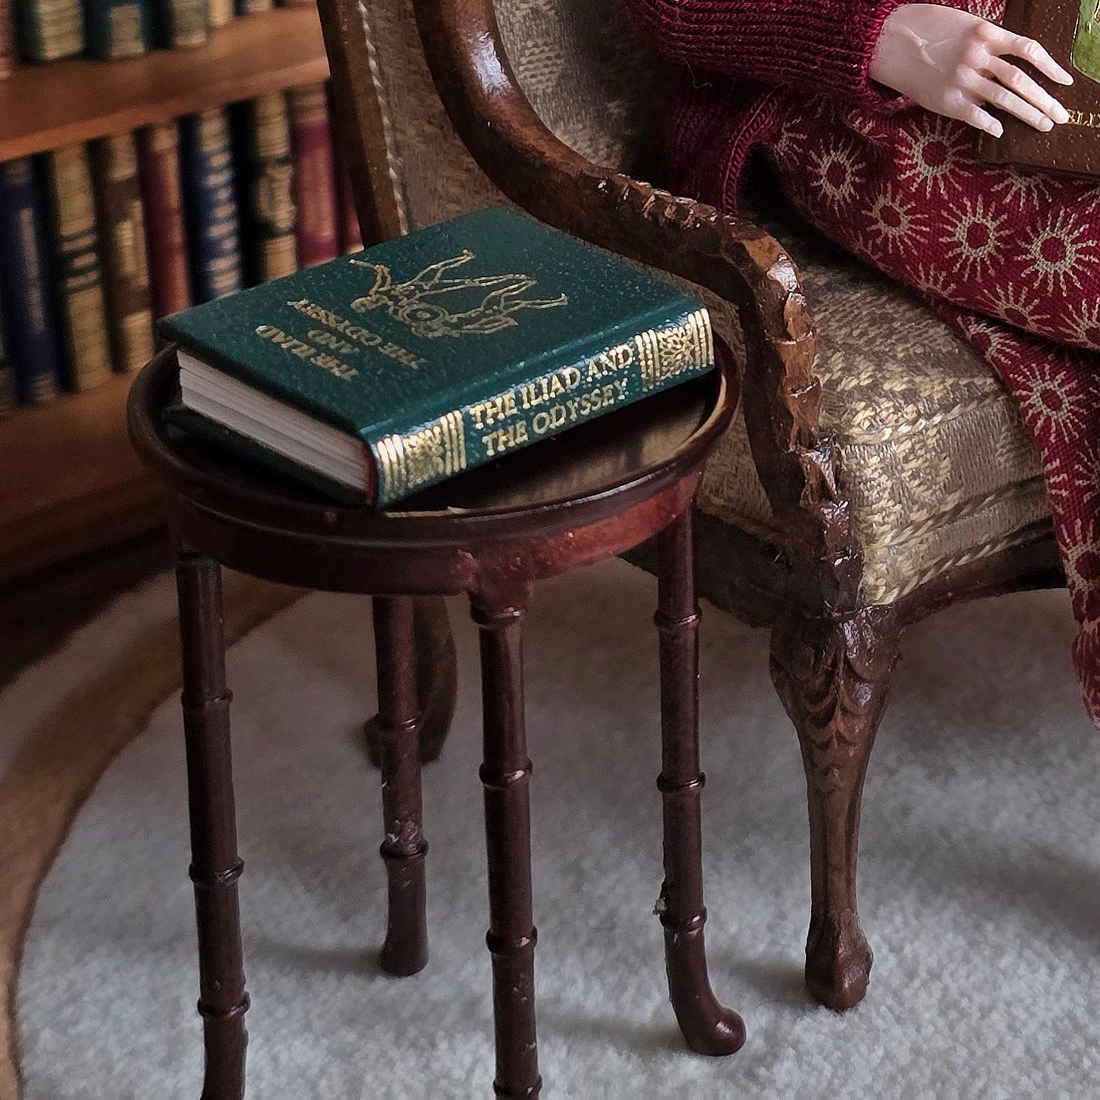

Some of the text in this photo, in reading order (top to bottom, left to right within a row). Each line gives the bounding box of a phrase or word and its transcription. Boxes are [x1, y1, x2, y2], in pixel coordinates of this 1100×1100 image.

[286, 298, 382, 346] ODYSSEY
[307, 329, 359, 355] AND
[255, 325, 359, 382] THE ILIAD
[469, 344, 634, 430] THE ILIAD AND
[482, 377, 628, 456] THE ODYSSEY
